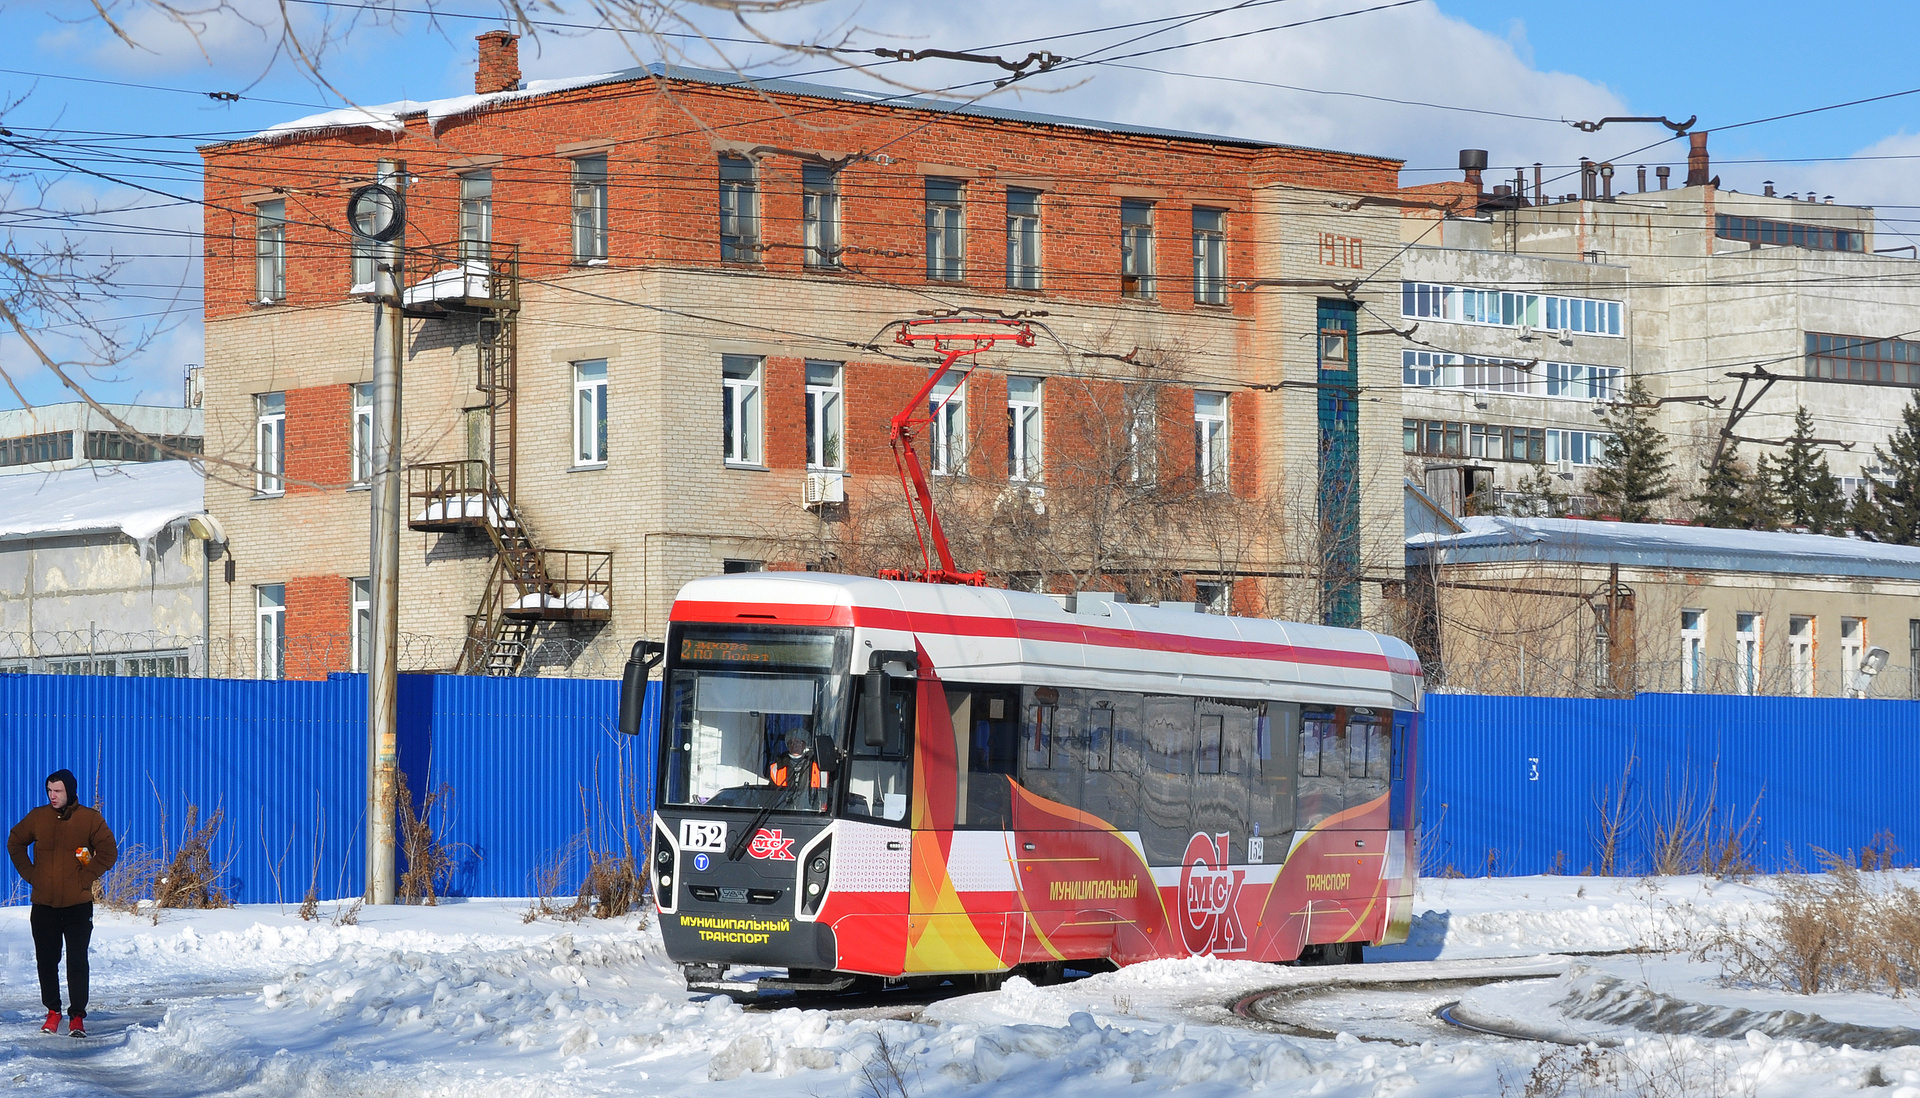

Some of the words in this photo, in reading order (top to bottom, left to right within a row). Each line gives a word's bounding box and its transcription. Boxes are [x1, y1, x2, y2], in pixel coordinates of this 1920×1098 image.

[1319, 232, 1363, 269] 1970
[681, 640, 691, 660] 2
[685, 824, 722, 848] 152
[1249, 840, 1262, 861] 152
[1050, 874, 1138, 901] МУНИЦИПАЛЬНЫЙ
[1306, 873, 1351, 891] ТРАНСПОРТ
[680, 915, 790, 932] МУНИЦИПАЛЬНЫЙ
[699, 930, 770, 944] ТРАНСПОРТ
